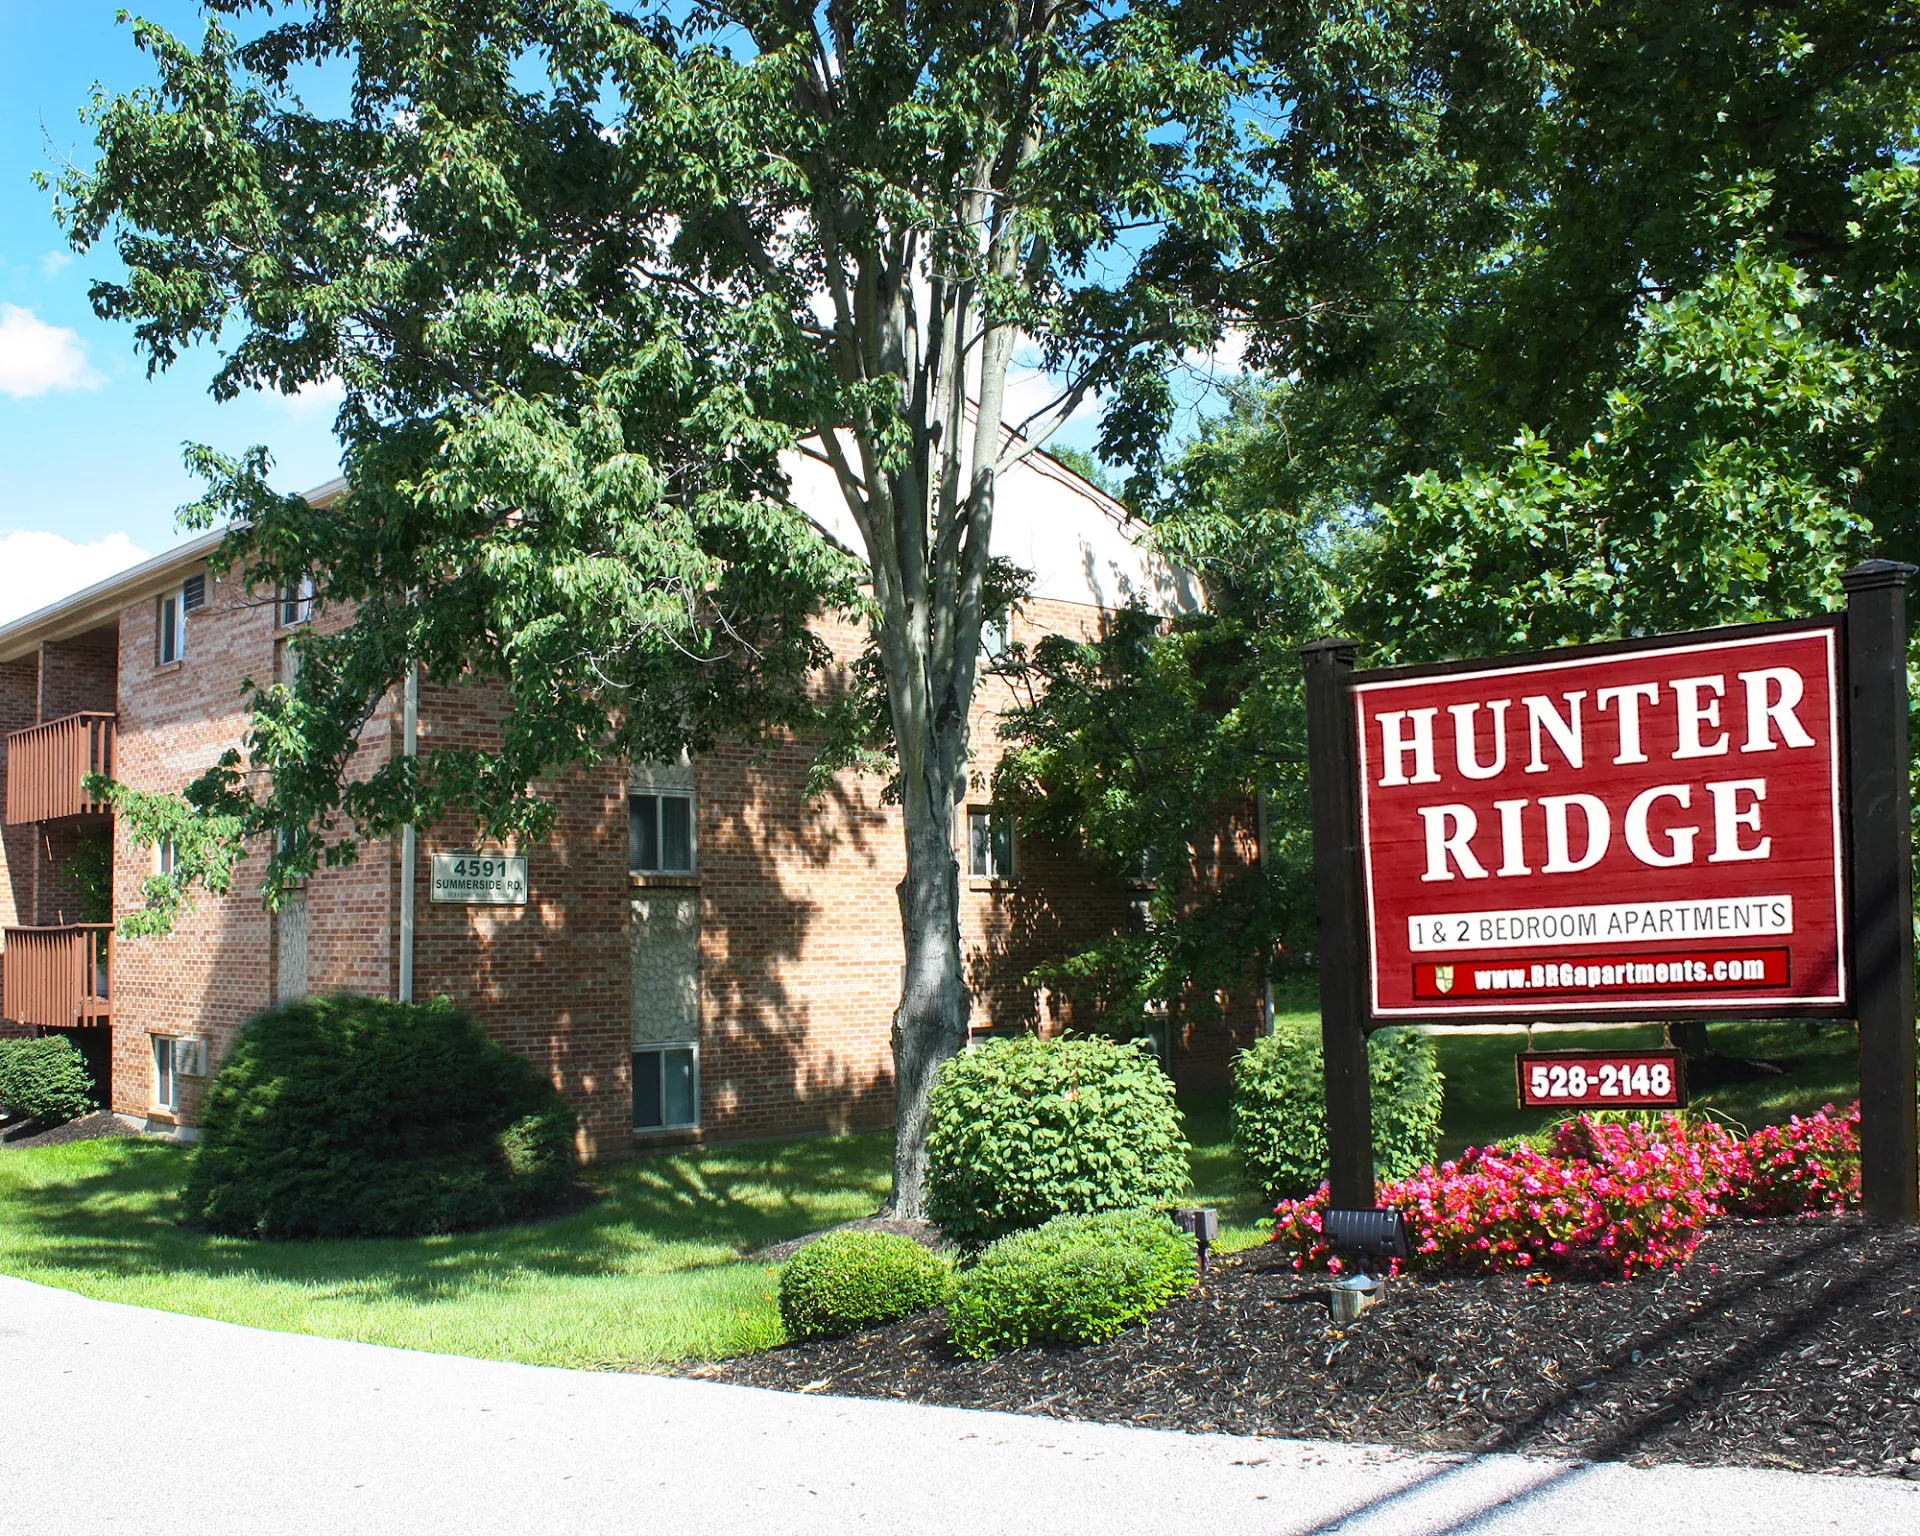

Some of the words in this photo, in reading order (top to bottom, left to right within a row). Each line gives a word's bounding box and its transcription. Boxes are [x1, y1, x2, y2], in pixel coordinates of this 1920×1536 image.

[1374, 666, 1815, 787] HUNTER
[1417, 778, 1772, 881] RIDGE
[436, 879, 502, 890] SUMMERSIDE
[507, 881, 523, 891] RD.
[454, 860, 506, 878] 4591
[1416, 923, 1424, 945] 1
[1432, 921, 1447, 944] &
[1456, 920, 1470, 942] 2
[1480, 913, 1597, 941] BEDROOM
[1607, 902, 1786, 935] APARTMENTS
[1474, 958, 1765, 990] www.BRGapartments.com
[1531, 1064, 1672, 1098] 528-2148
